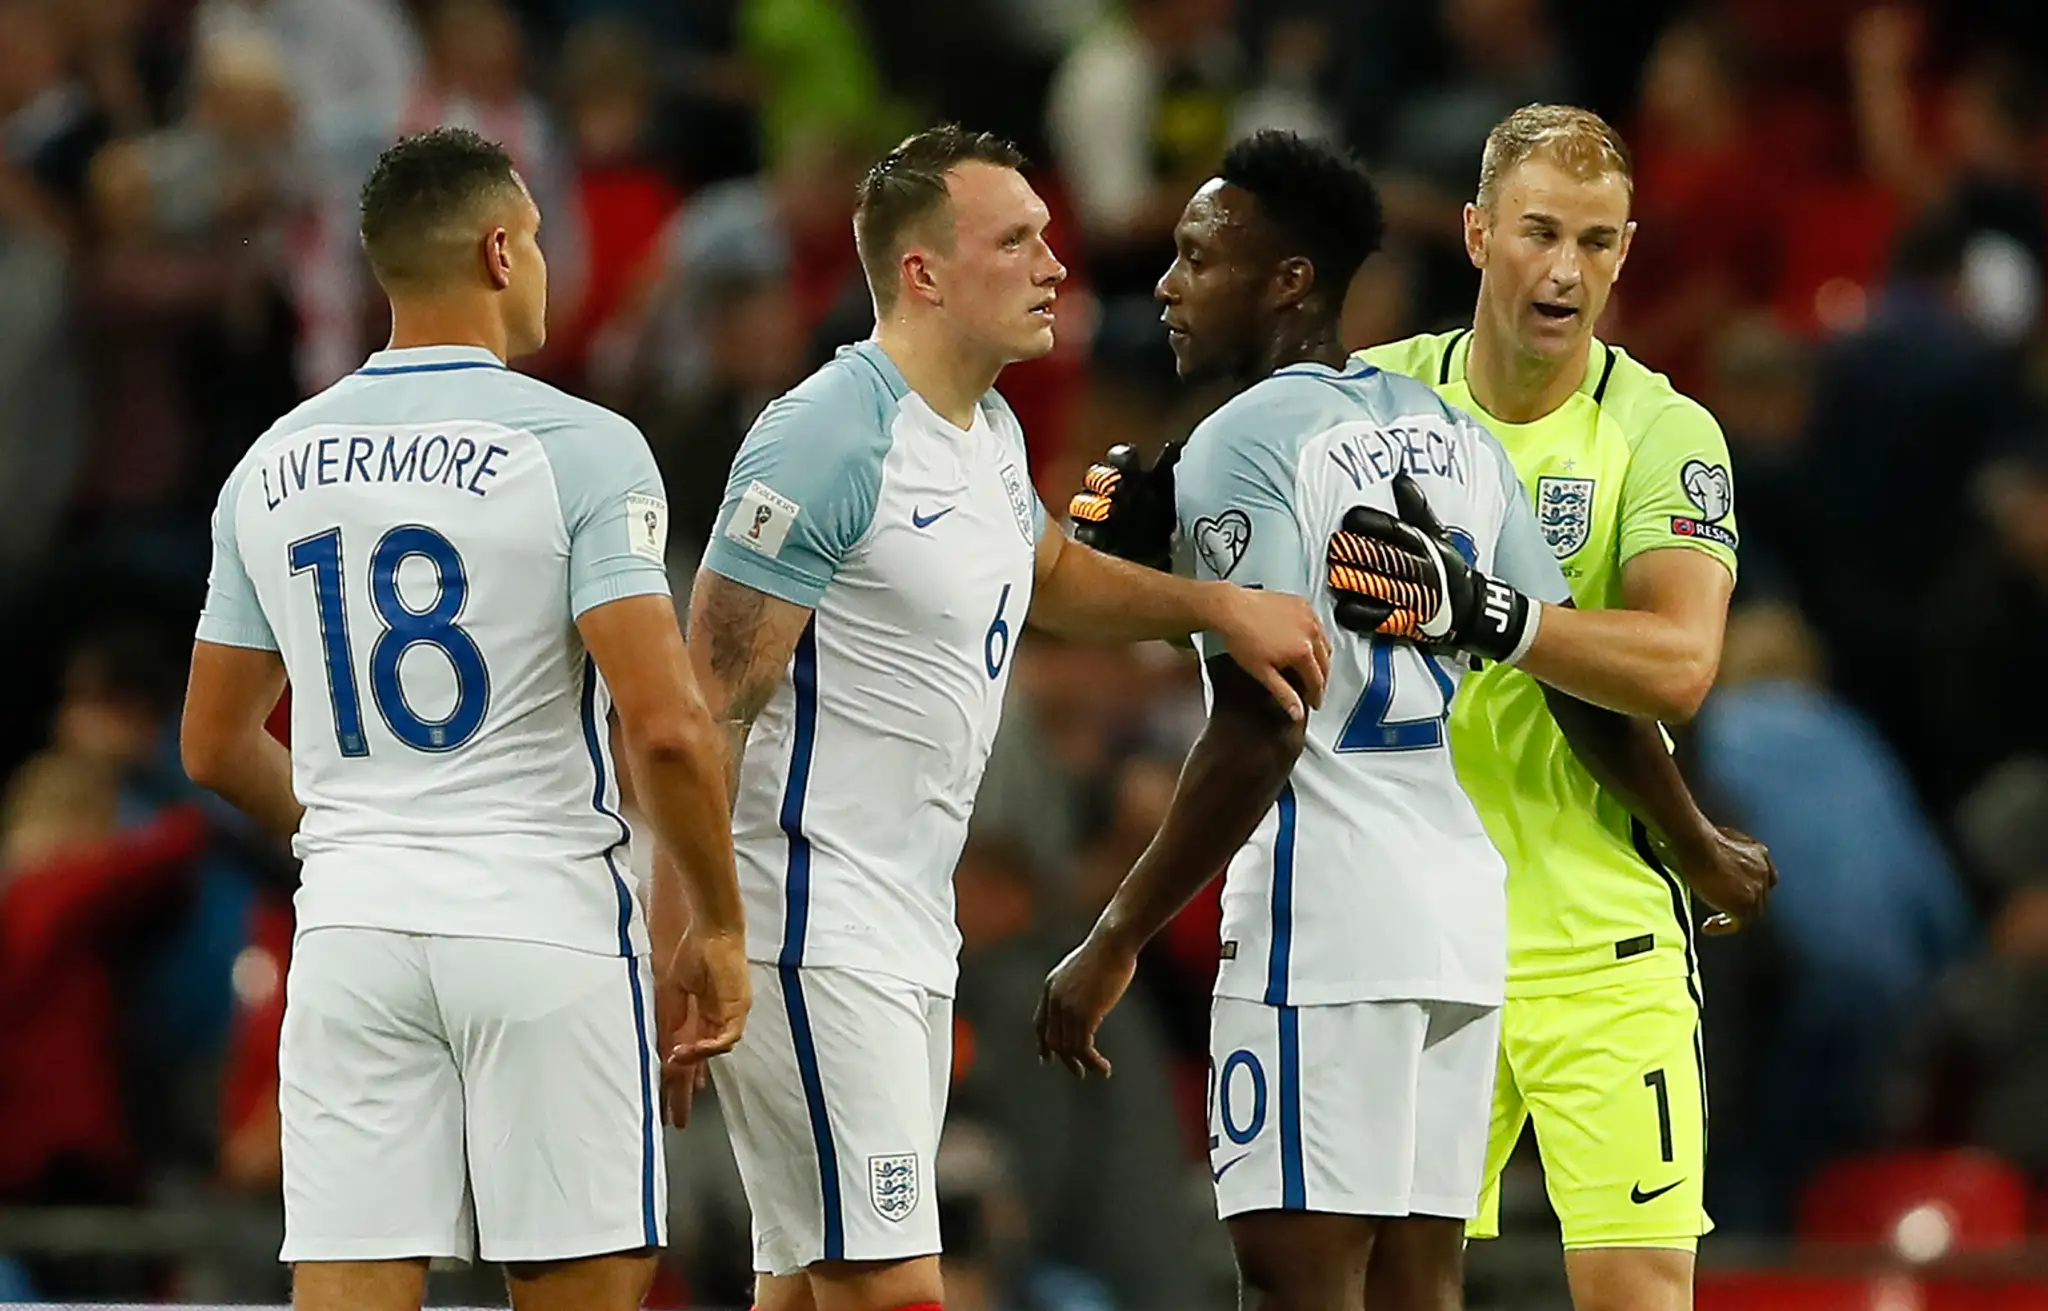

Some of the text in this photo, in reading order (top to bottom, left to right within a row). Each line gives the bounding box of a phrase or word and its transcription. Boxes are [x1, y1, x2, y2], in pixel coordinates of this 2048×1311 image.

[261, 435, 509, 511] LIVERMORE
[1695, 523, 1735, 546] RESP
[288, 524, 490, 758] 18
[985, 583, 1011, 680] 6
[1484, 582, 1511, 633] JH
[1204, 1049, 1267, 1149] 0
[1644, 1068, 1674, 1162] 1
